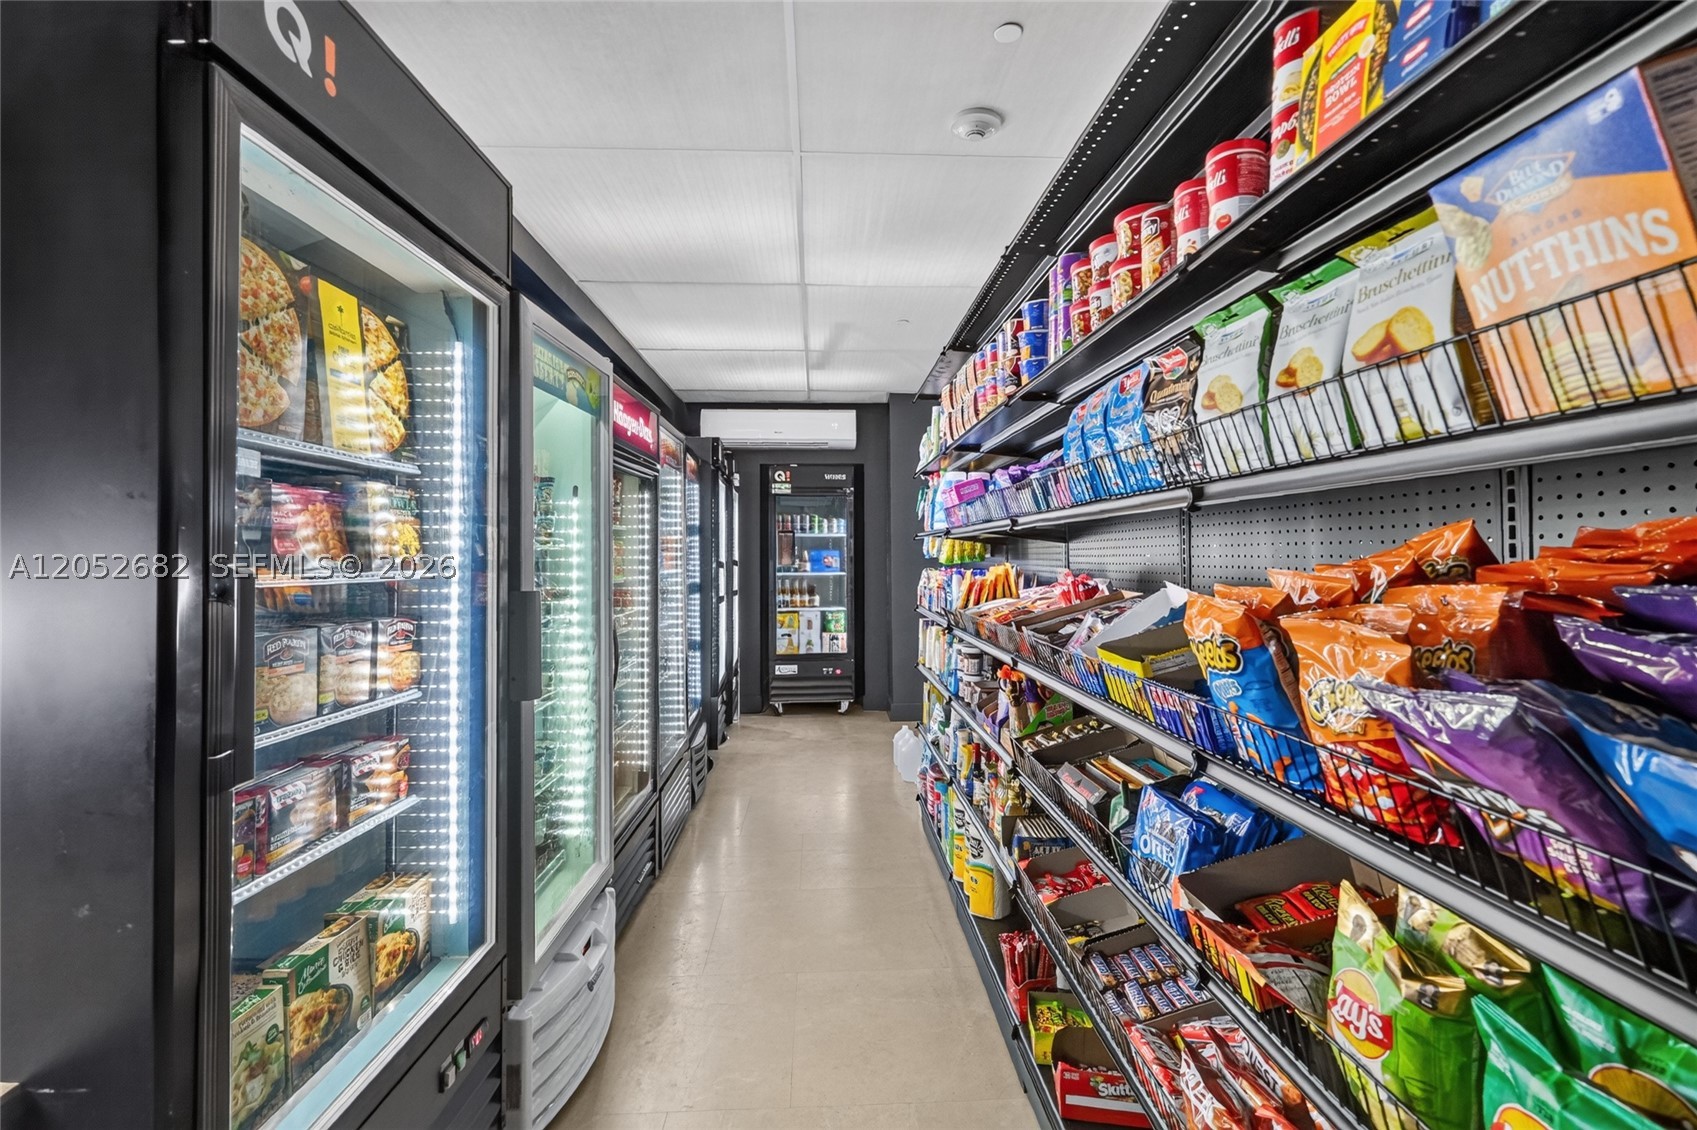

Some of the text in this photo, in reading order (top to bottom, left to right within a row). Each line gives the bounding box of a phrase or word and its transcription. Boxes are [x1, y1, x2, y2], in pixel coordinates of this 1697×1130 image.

[1324, 62, 1361, 98] PROTEIN
[1325, 76, 1358, 108] BOWL
[1495, 159, 1565, 203] DIAMOND
[1508, 159, 1544, 187] BLUE
[1510, 208, 1583, 246] ALMOND
[1470, 208, 1679, 321] NUT-THINS
[774, 470, 791, 482] Q!
[266, 641, 282, 656] RED
[1140, 833, 1175, 867] OREO
[332, 938, 364, 967] CHICKEN
[1332, 980, 1384, 1041] Lay's
[1098, 1082, 1134, 1097] Skitt
